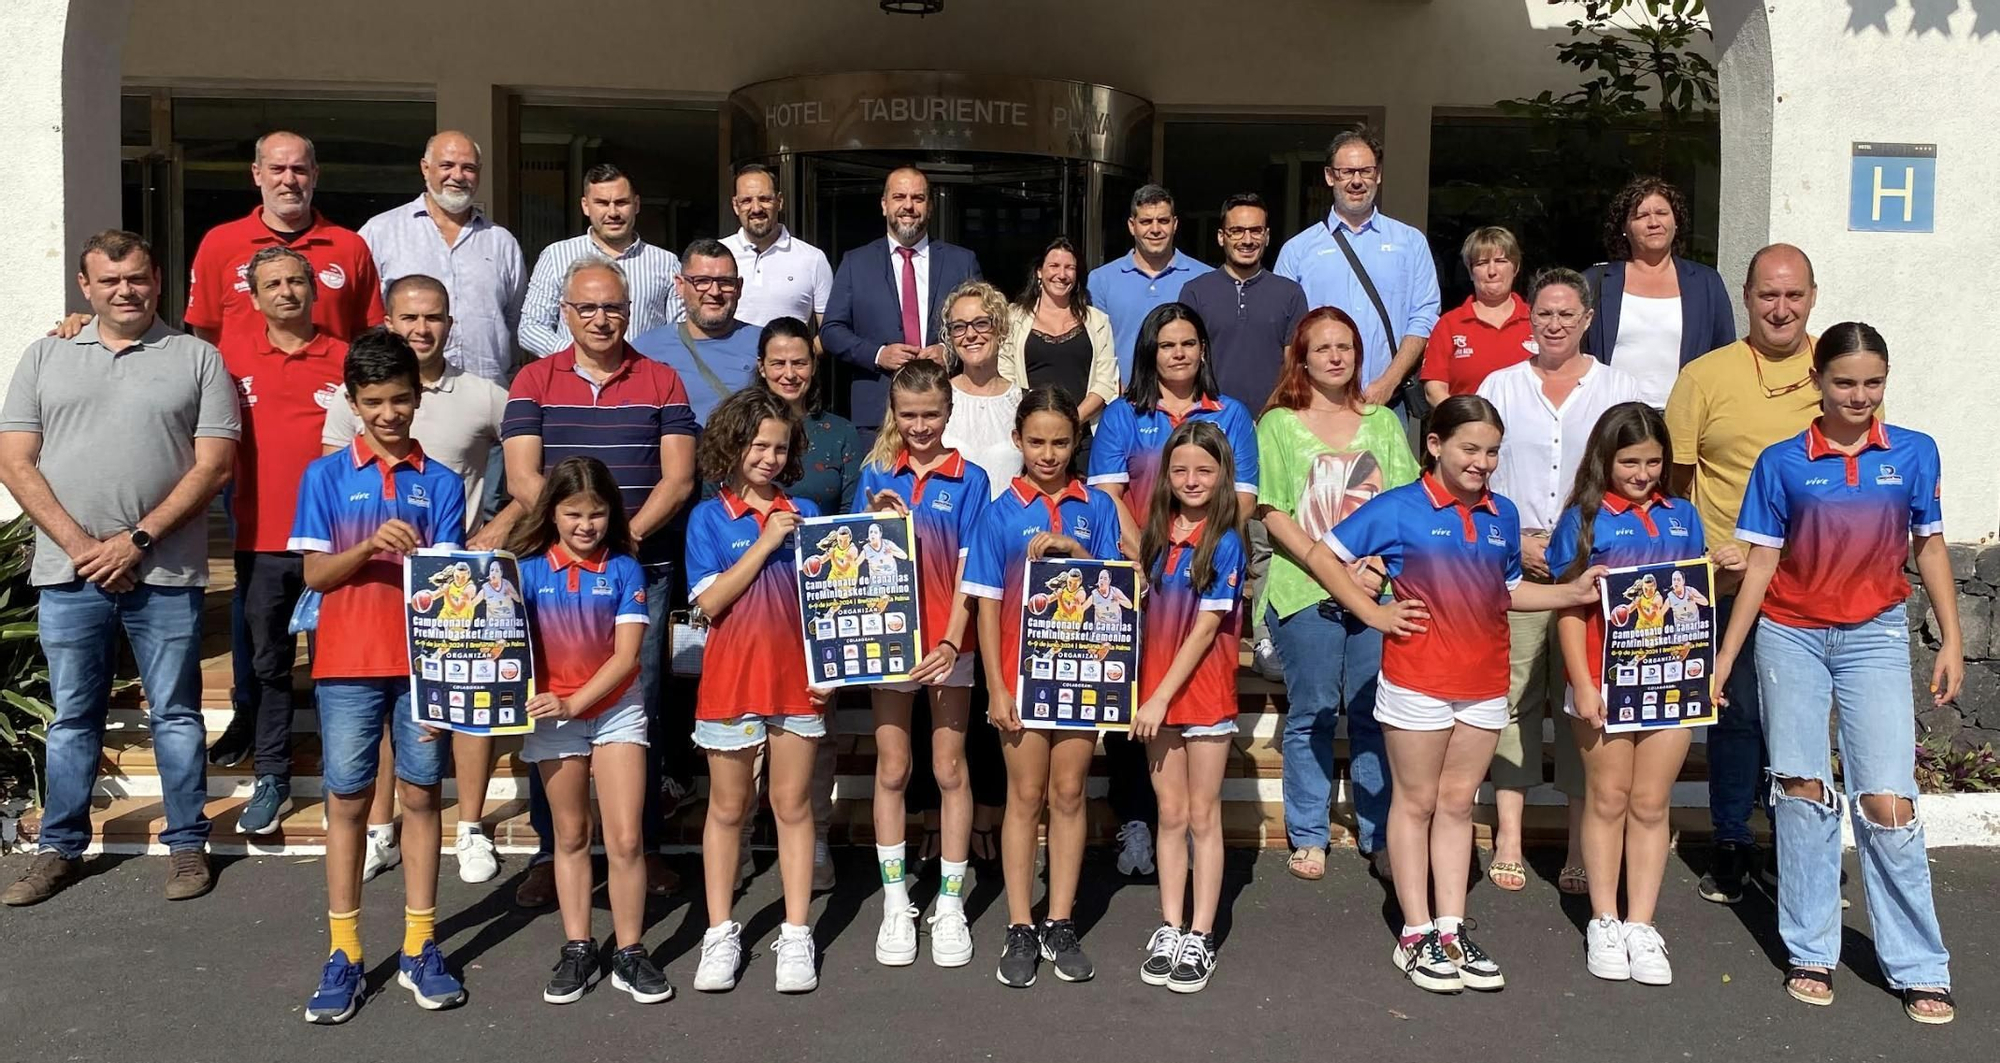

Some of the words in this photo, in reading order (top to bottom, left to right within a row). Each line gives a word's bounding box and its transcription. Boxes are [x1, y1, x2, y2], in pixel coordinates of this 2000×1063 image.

[765, 101, 831, 129] HOTEL
[859, 97, 1028, 126] TABURIENTE
[1054, 107, 1114, 138] PLAYA
[1872, 166, 1914, 222] H
[805, 579, 857, 591] Campeonato
[859, 576, 869, 586] de
[870, 574, 909, 585] Canarias
[806, 586, 867, 601] PreMinibasket
[869, 584, 909, 595] Femenino
[413, 616, 471, 629] Campeonato
[474, 618, 485, 628] de
[488, 617, 524, 628] Canarias
[1027, 618, 1081, 630] Campeonato
[1083, 621, 1094, 631] de
[1095, 622, 1132, 632] Canarias
[413, 627, 481, 639] PreMinibasket
[484, 629, 525, 639] Femenino
[1027, 628, 1089, 641] PreMinibasket
[1091, 633, 1131, 643] Femenino
[1612, 627, 1663, 640] Campeonato
[1664, 625, 1674, 634] de
[1673, 630, 1709, 643] Femenino
